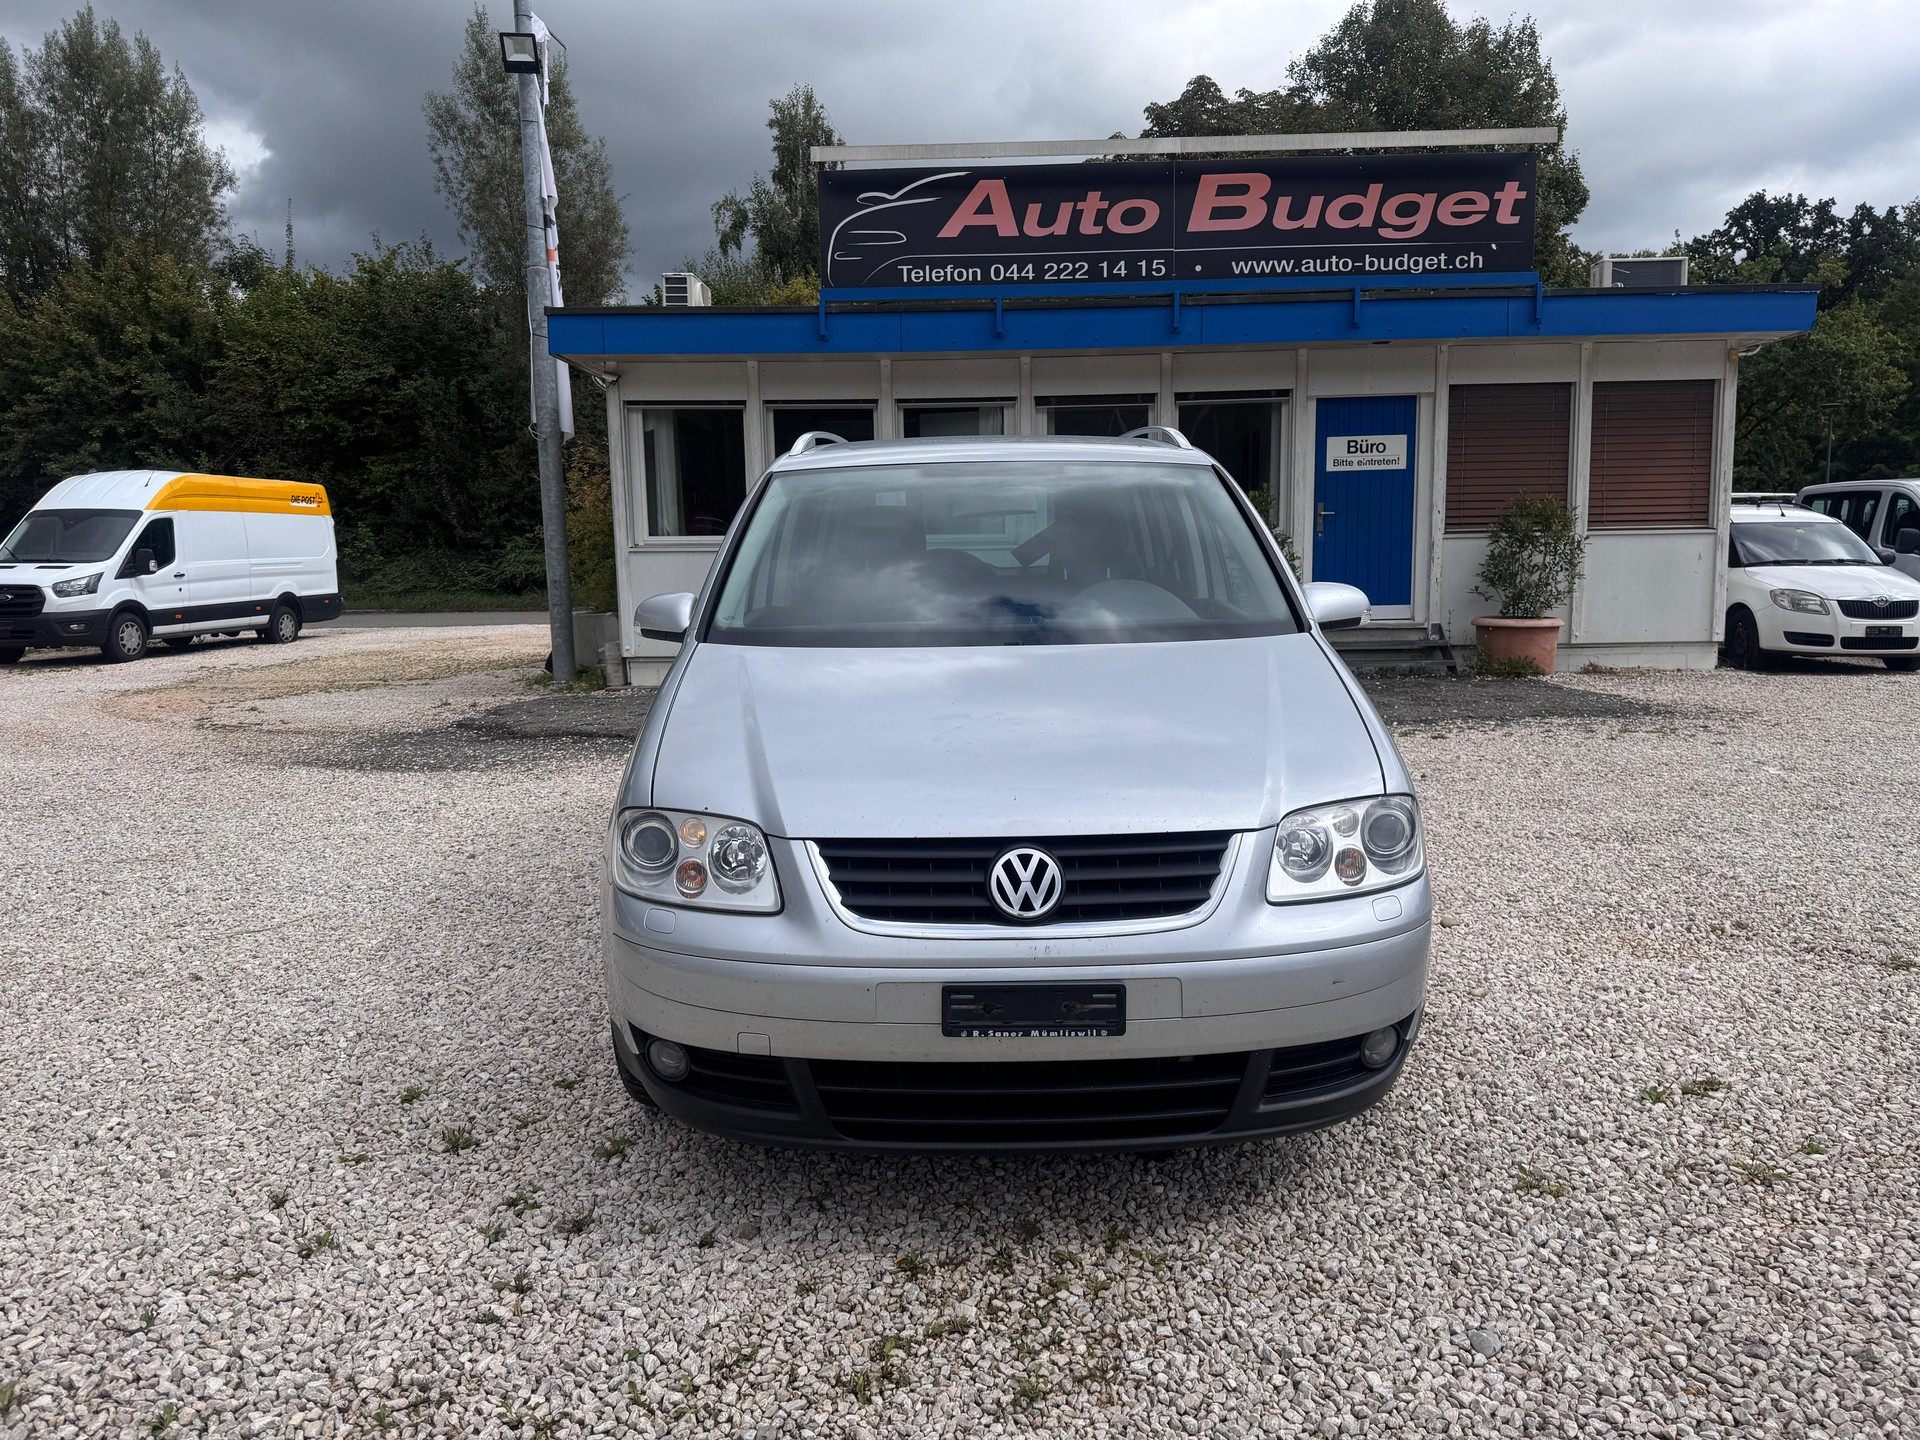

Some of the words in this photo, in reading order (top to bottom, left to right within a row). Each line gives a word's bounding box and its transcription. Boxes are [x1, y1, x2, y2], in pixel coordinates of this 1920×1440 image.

[937, 180, 1160, 238] Auto
[1187, 173, 1527, 239] Budget
[898, 265, 982, 283] Telefon
[990, 263, 1035, 281] 044
[1043, 261, 1089, 280] 222
[1098, 260, 1128, 278] 14
[1137, 259, 1166, 277] 15
[1231, 251, 1484, 274] www.auto-budget.ch
[1347, 439, 1386, 454] Büro
[1333, 459, 1354, 467] Bitte
[1357, 457, 1400, 466] eintreten!
[291, 495, 300, 503] DIE
[301, 496, 315, 505] POST
